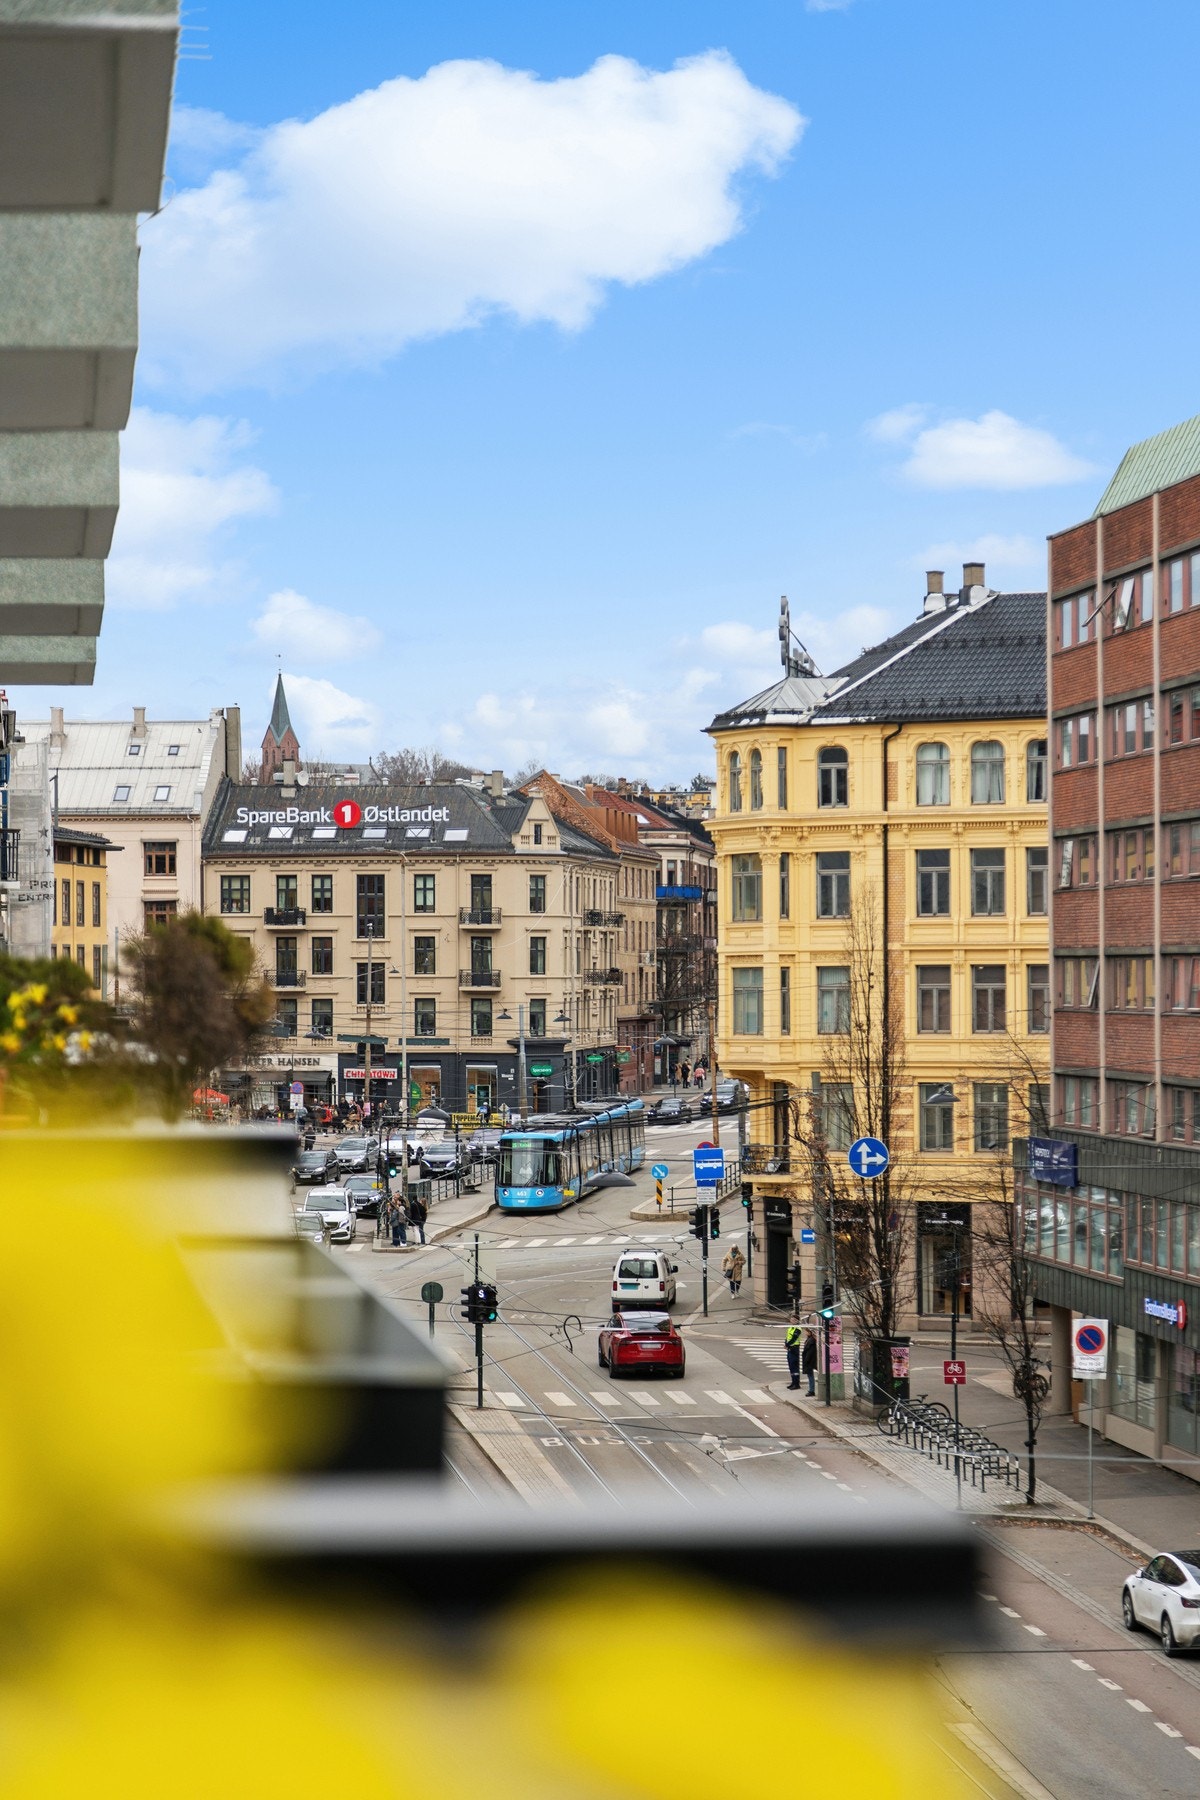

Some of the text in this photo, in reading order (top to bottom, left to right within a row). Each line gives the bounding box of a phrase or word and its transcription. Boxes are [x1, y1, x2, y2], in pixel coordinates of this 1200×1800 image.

[236, 805, 450, 827] SpareBank 1 Østlandet
[277, 1057, 321, 1066] HANSEN
[540, 1435, 654, 1447] BUSS
